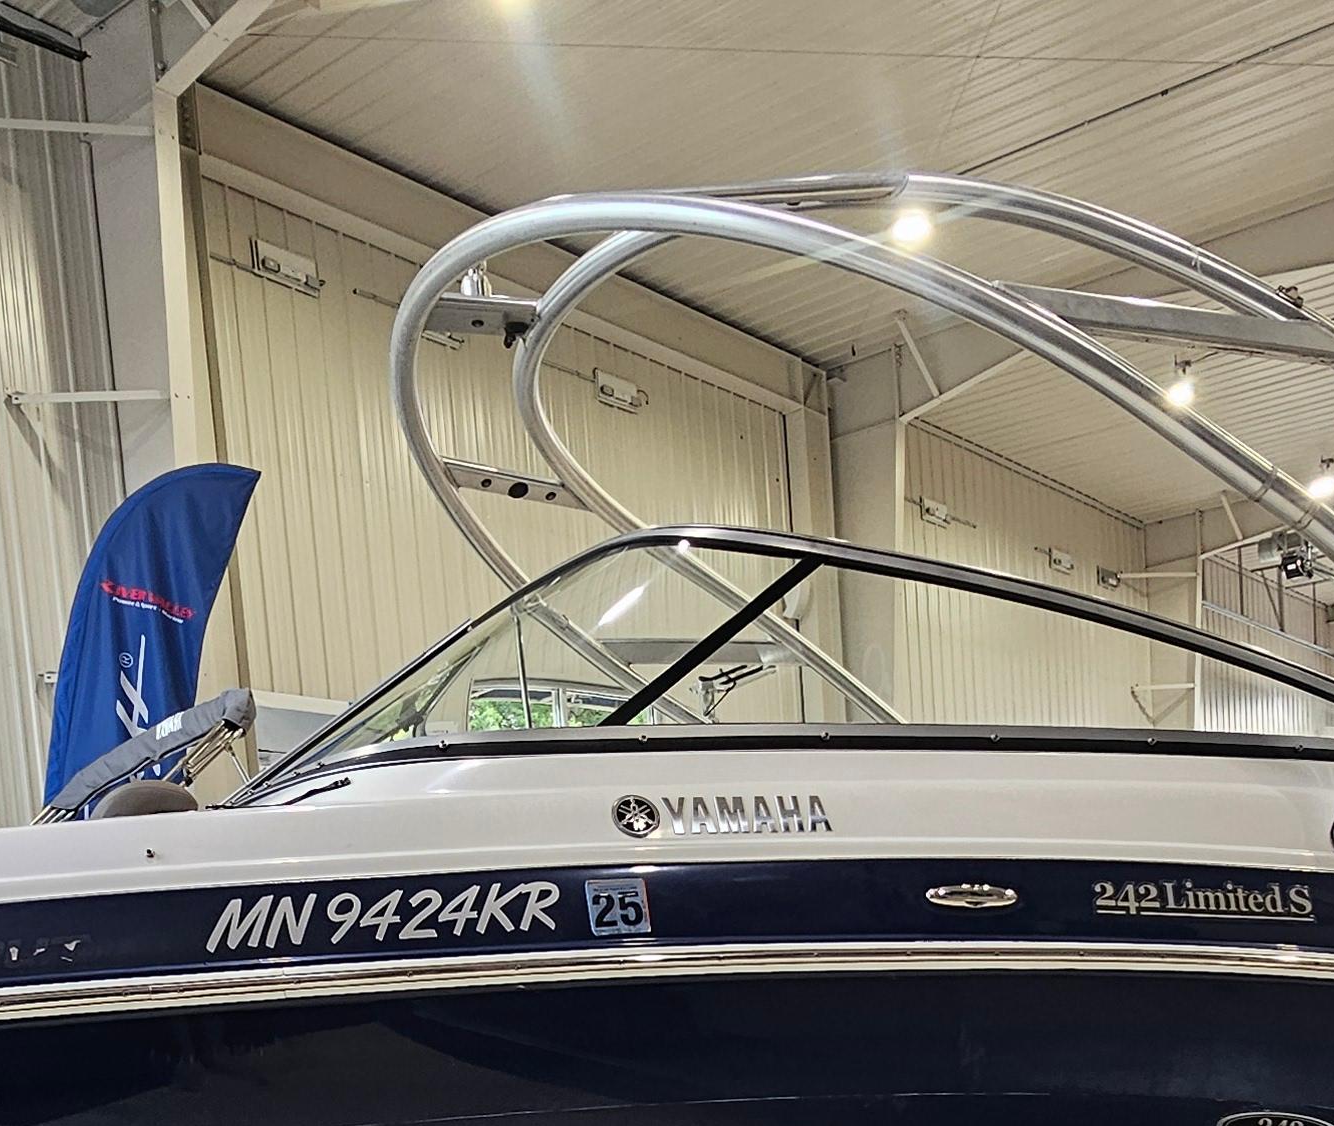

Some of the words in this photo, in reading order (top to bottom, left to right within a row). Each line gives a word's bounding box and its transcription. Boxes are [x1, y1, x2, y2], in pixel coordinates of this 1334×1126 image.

[661, 795, 833, 835] YAMAHA
[592, 890, 644, 928] 25
[1093, 880, 1161, 914] 242
[1162, 878, 1283, 913] Limited
[1288, 884, 1314, 915] S
[206, 893, 317, 953] MN
[326, 881, 561, 945] 9424KR
